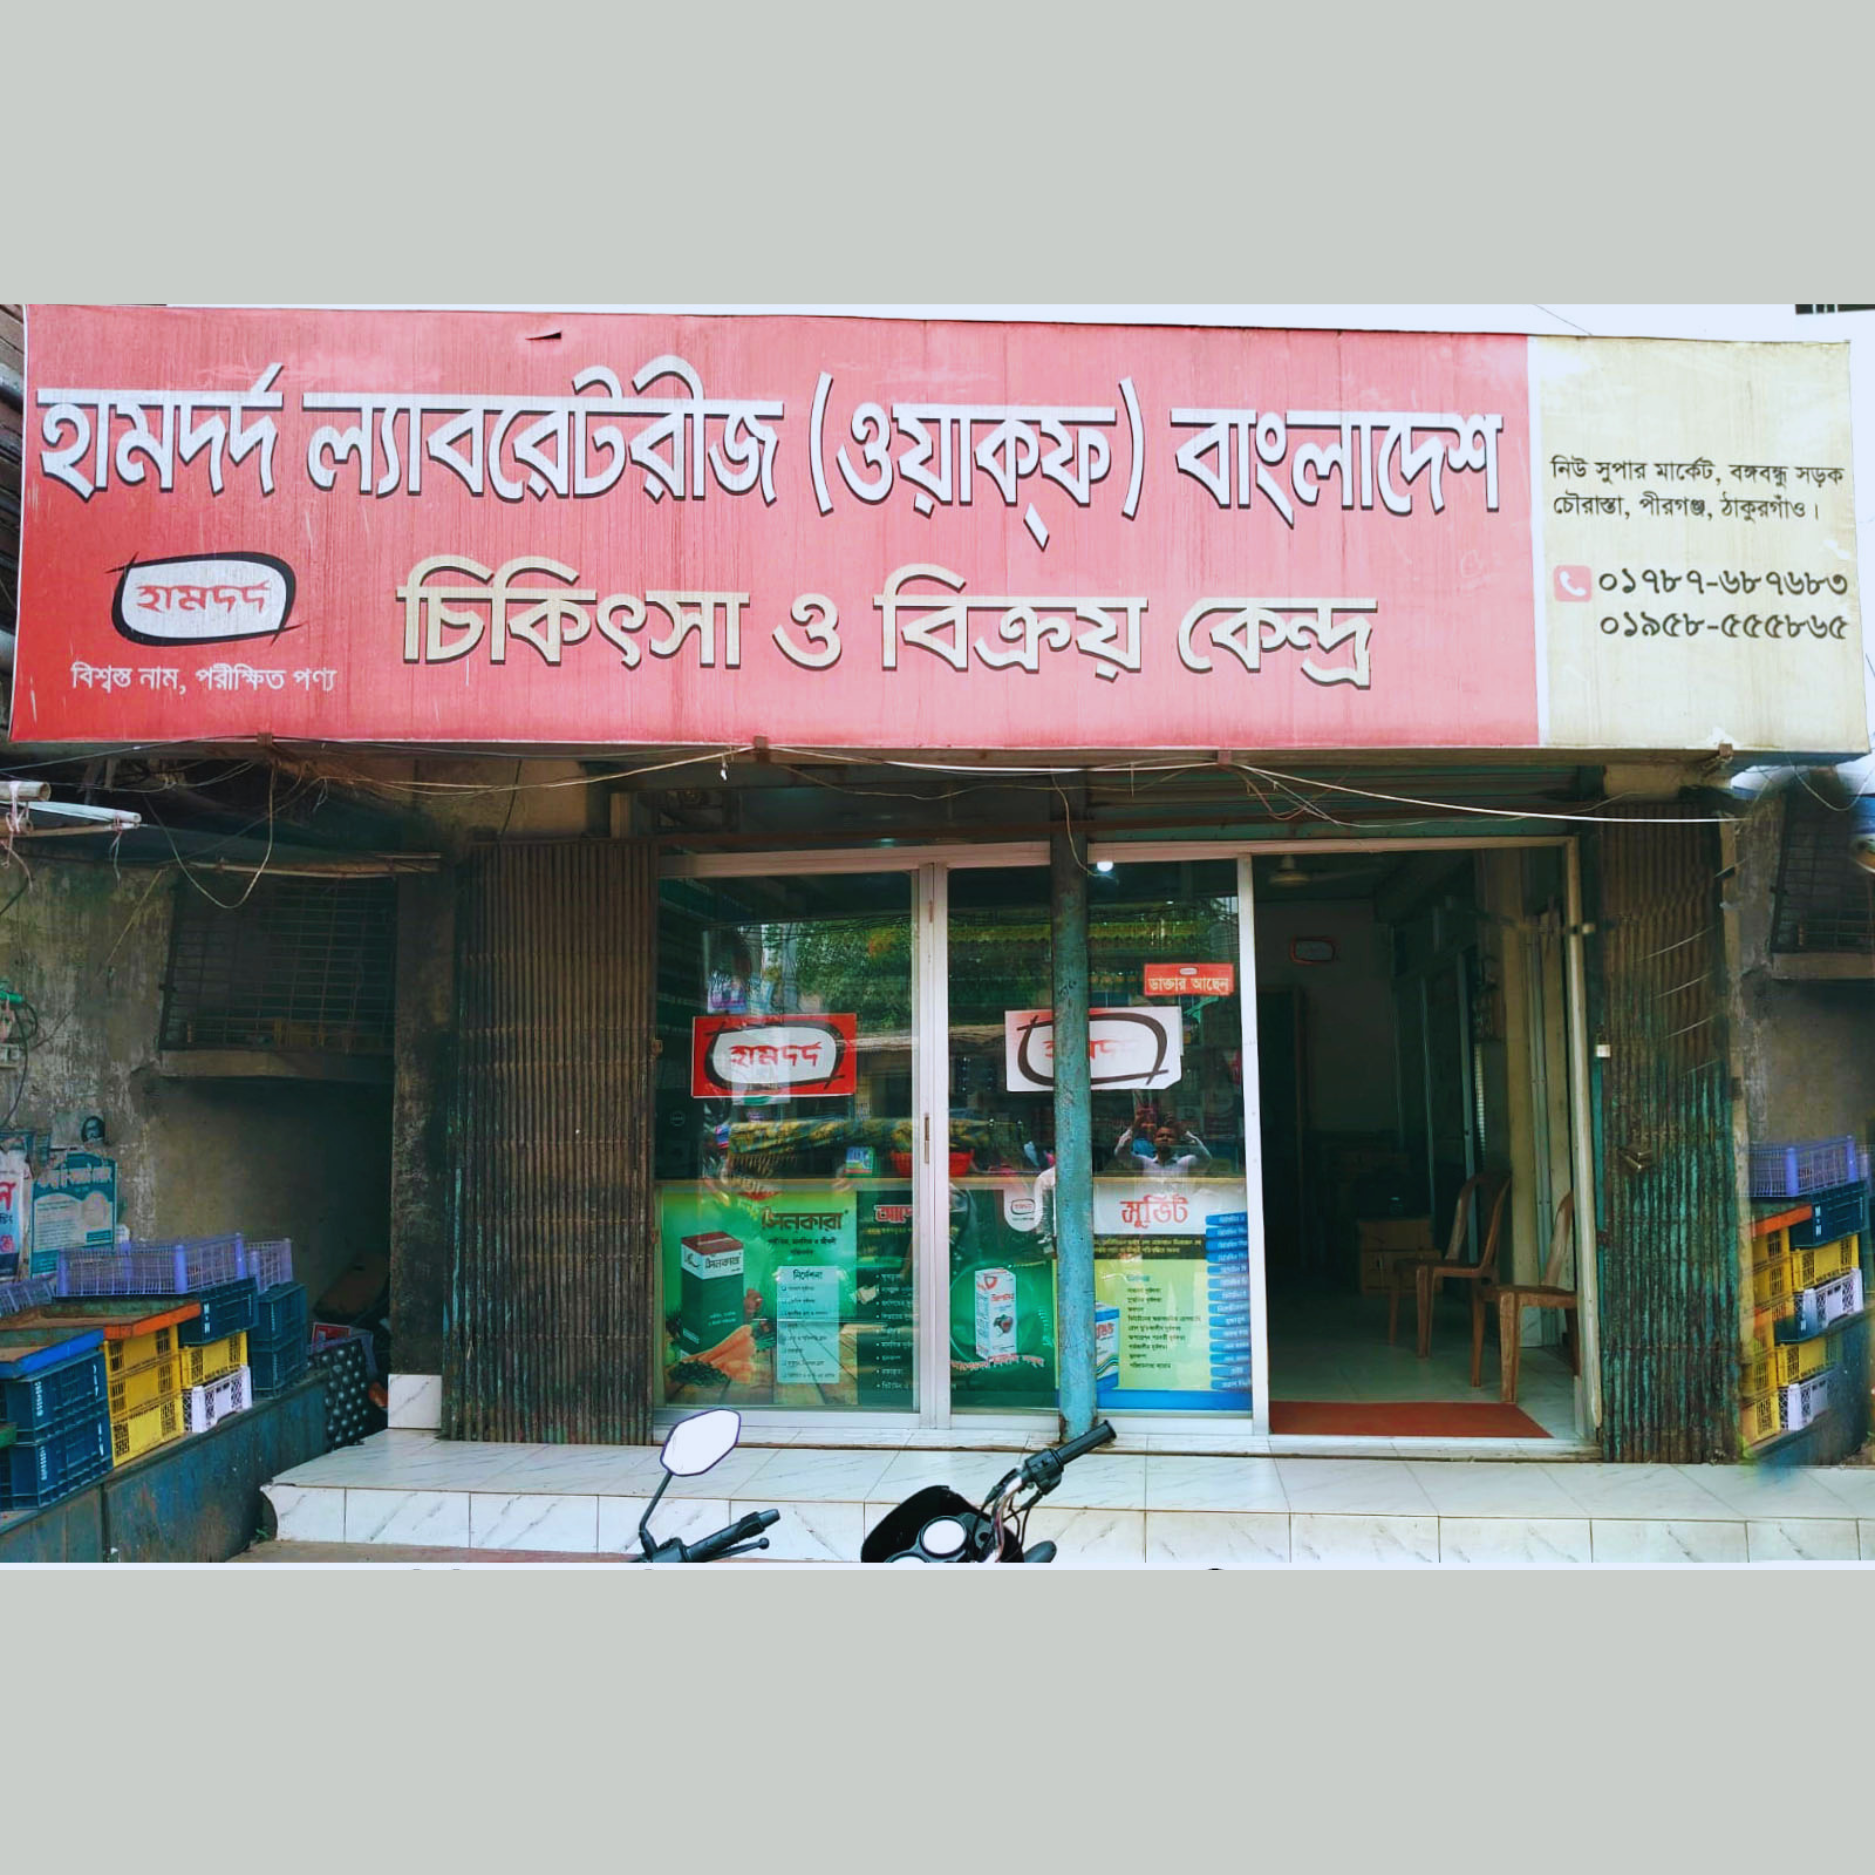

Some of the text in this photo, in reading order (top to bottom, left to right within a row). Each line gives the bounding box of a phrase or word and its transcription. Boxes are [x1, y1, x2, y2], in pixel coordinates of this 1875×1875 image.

[38, 362, 283, 501] হামদর্দ
[303, 355, 784, 503] ল্যাবরেটরীজ
[1170, 408, 1503, 527] বাংলাদেশ
[1550, 455, 1845, 488] নিউ সুপার মার্কেট, বঙ্গবন্ধু সড়ক
[134, 580, 271, 613] হামদর্দ
[1599, 568, 1848, 595] ০১৭৮৭-৬৮৭৬৮৩
[397, 555, 1377, 688] চিকিৎসা ও বিক্রয় কেন্দ্র
[1600, 612, 1848, 639] ০১৯৫৮-৫৫৫৮৬৫
[71, 661, 337, 695] বিশ্বস্ত নাম, পরীক্ষিত পণ্য
[1148, 976, 1229, 994] ডাক্তার আছেন
[729, 1042, 822, 1067] হামদর্দ
